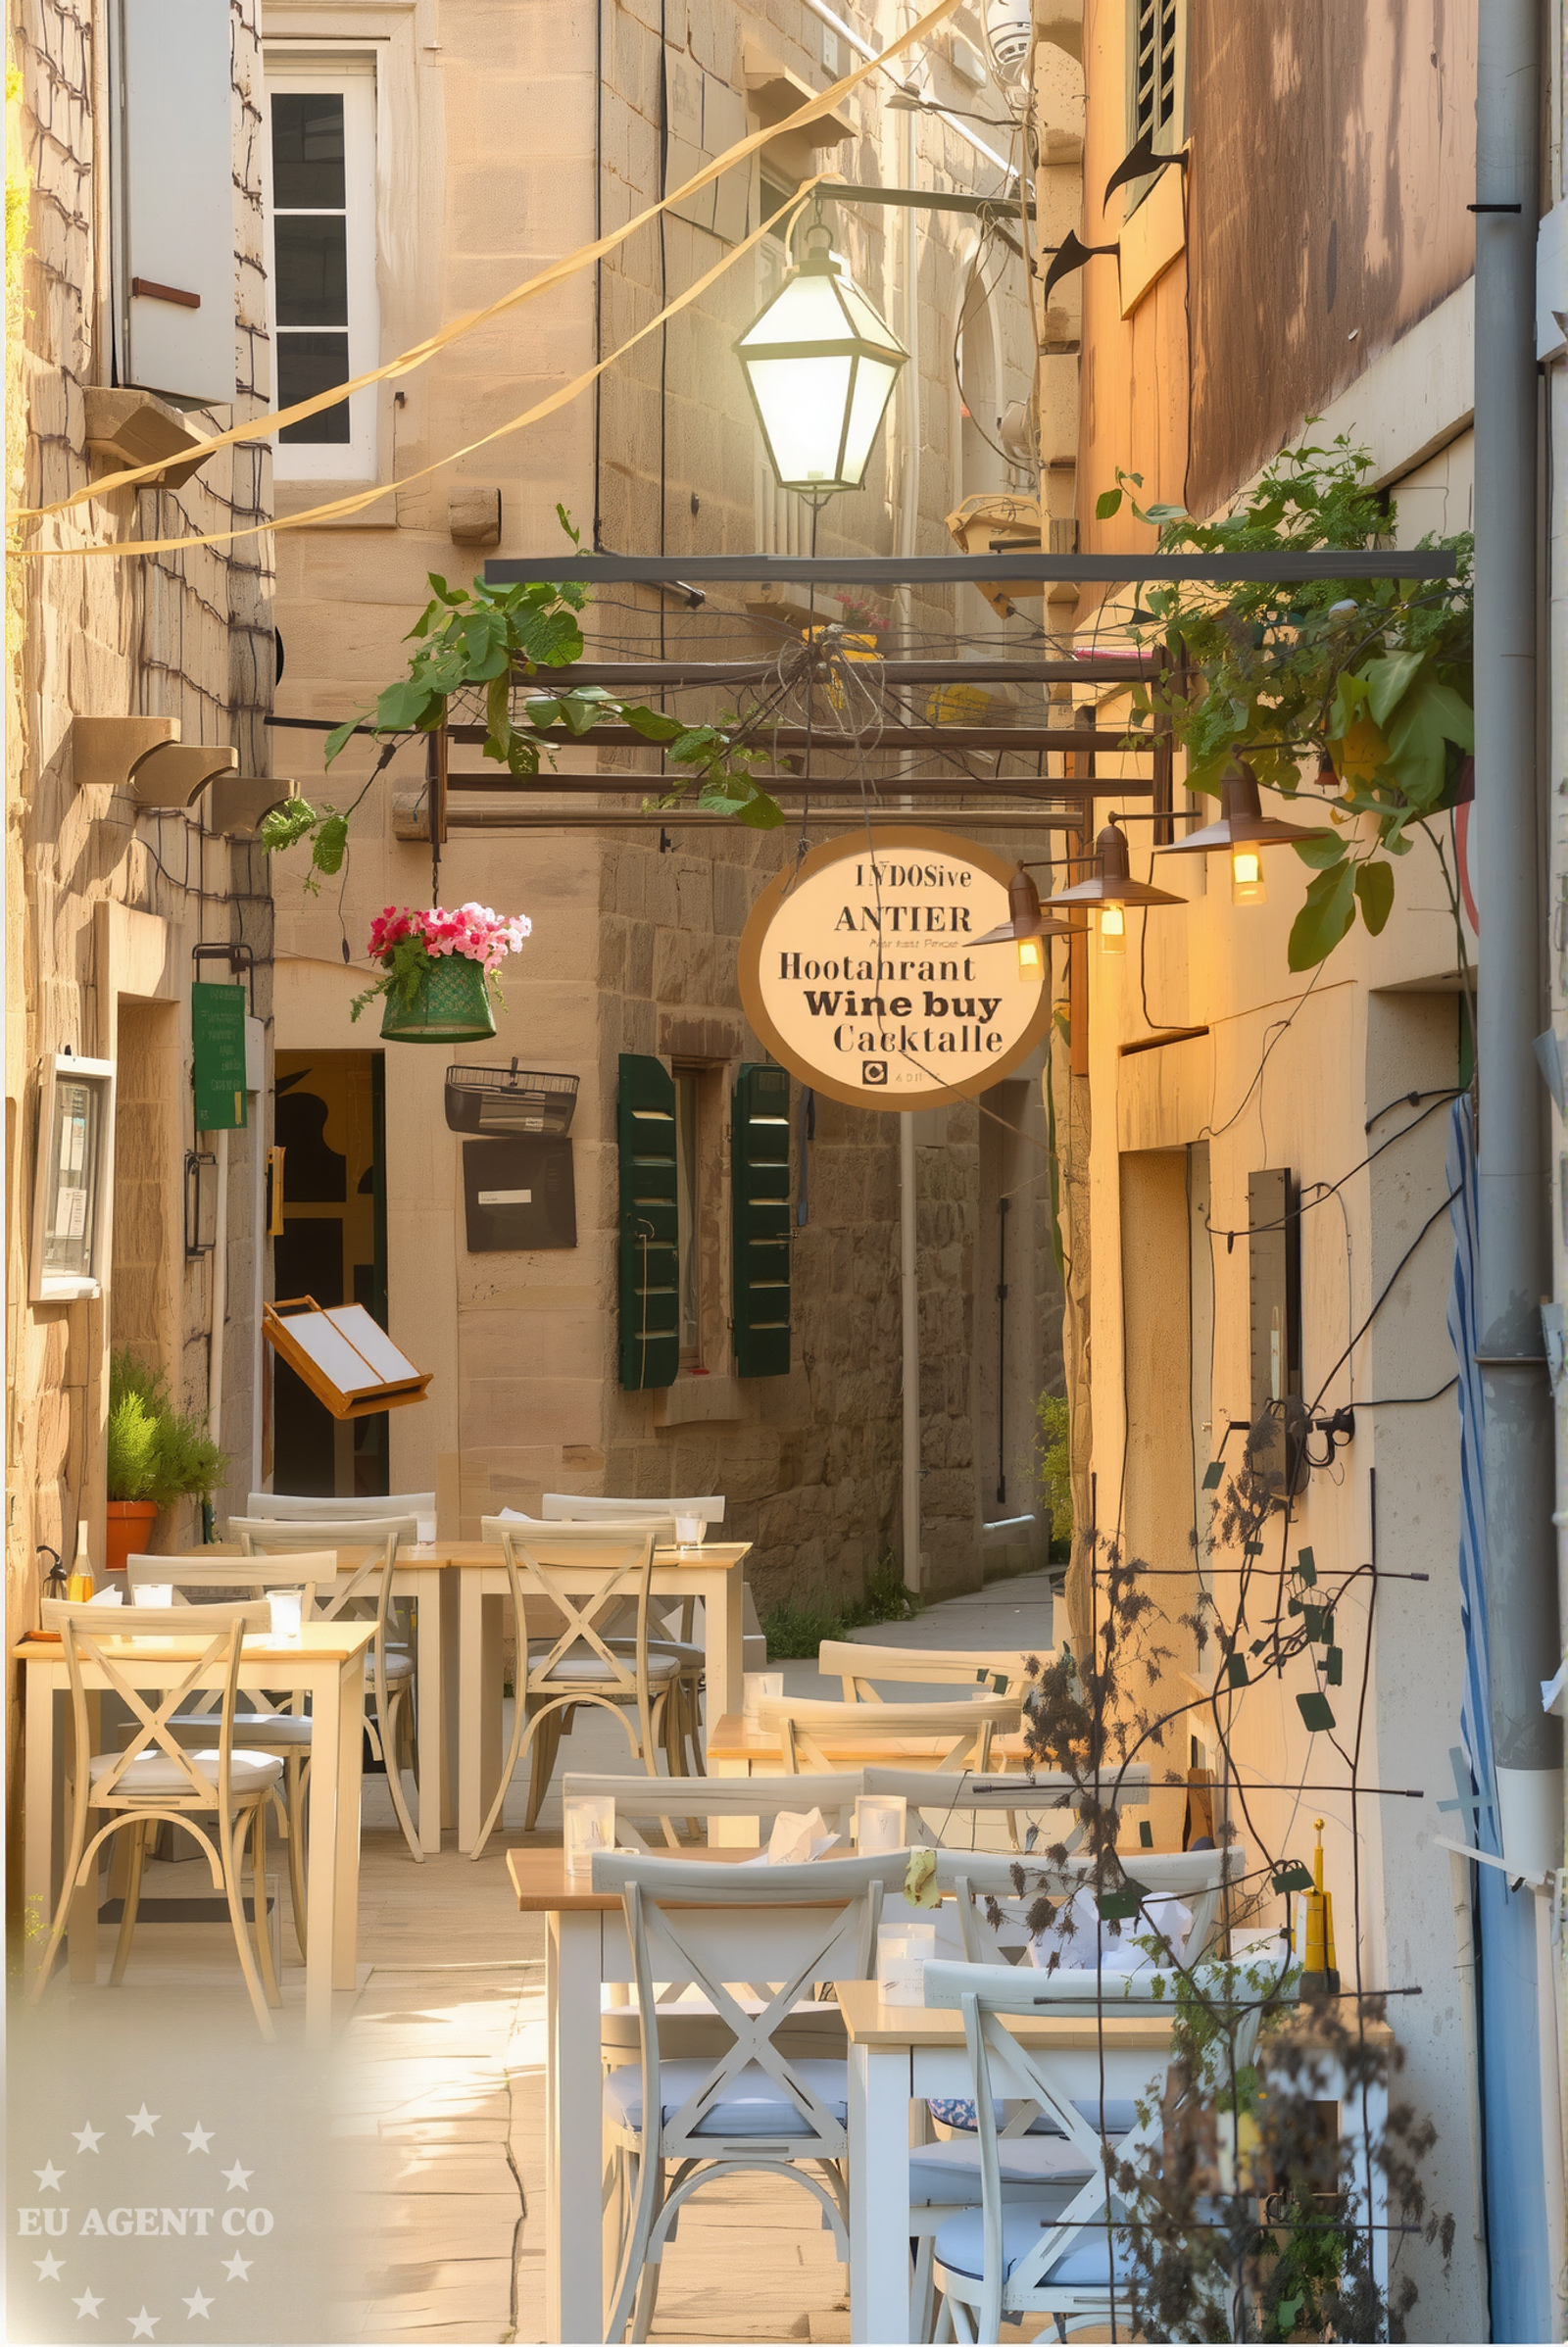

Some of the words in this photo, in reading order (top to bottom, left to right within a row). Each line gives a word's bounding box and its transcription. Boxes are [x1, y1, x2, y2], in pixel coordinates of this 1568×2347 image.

[834, 905, 972, 932] ANTIER
[804, 990, 911, 1016] Wine
[923, 991, 1002, 1024] buy
